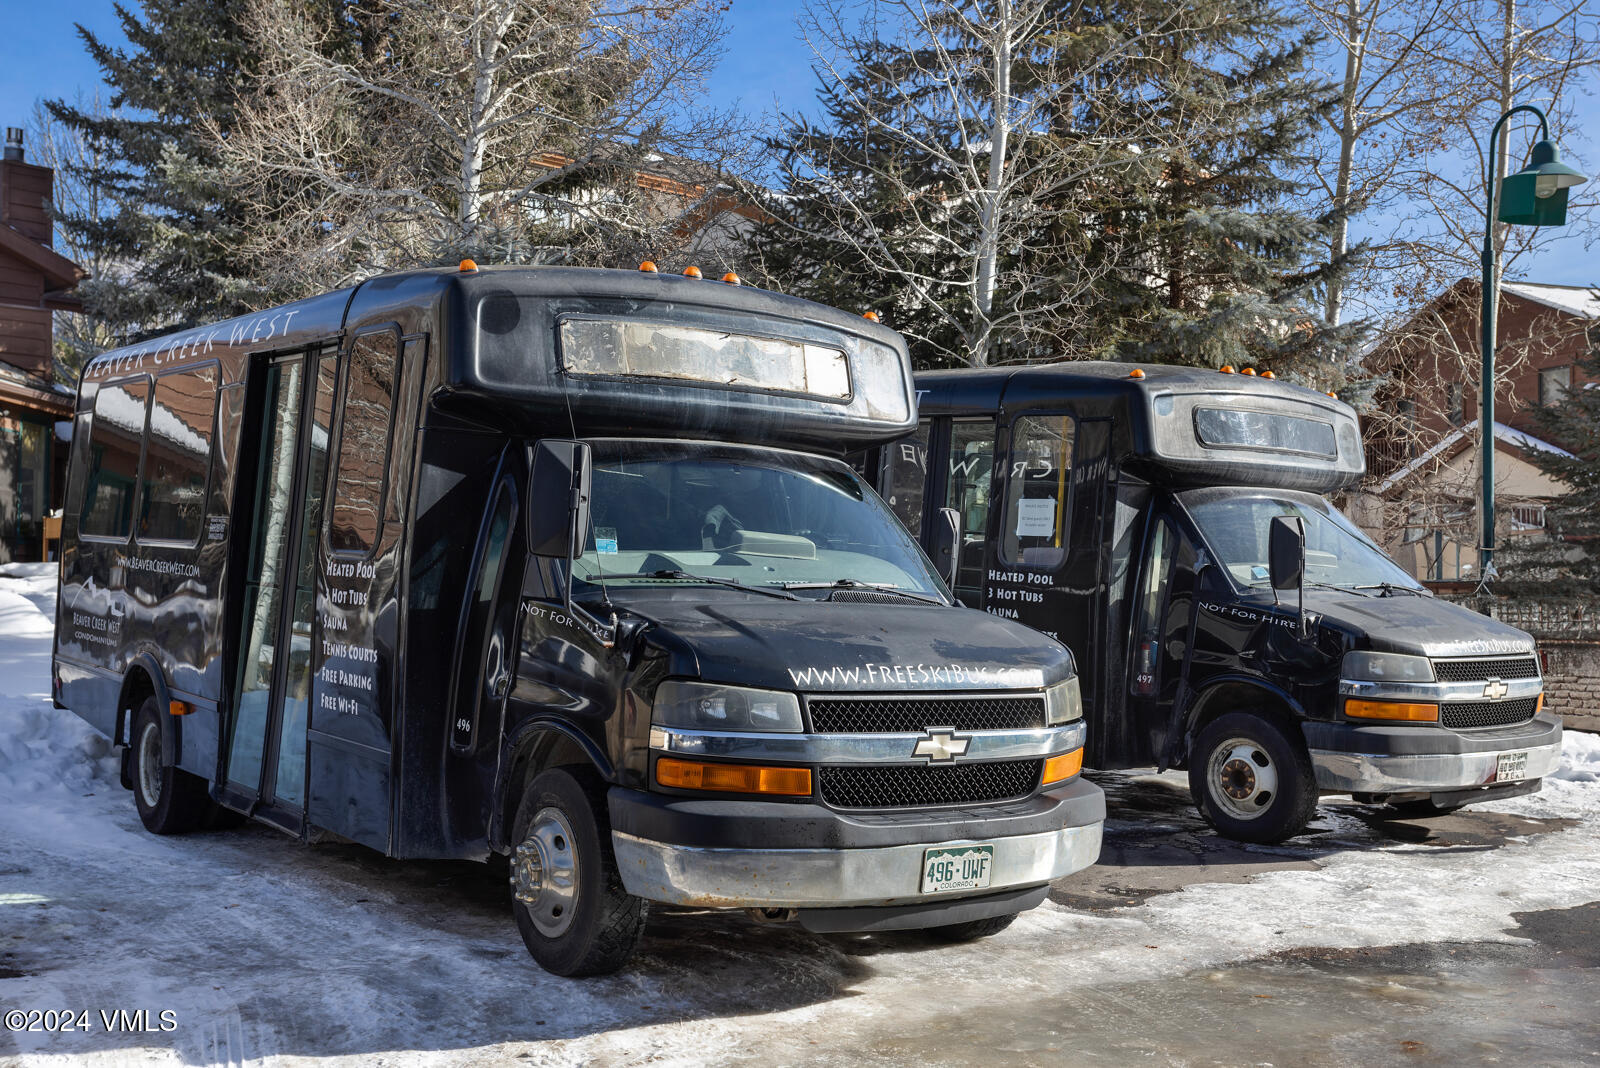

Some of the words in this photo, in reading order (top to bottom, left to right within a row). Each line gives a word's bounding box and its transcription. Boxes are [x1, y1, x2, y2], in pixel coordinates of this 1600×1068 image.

[84, 349, 148, 379] BEAVER
[154, 330, 220, 365] CREEK
[229, 310, 299, 348] WEST
[326, 561, 355, 577] HEATED
[356, 561, 376, 579] POOL
[988, 569, 1025, 583] HEATED
[1027, 572, 1054, 585] POOL
[331, 588, 348, 604] HOT
[348, 589, 367, 606] TUBS
[988, 587, 994, 598] 3
[997, 588, 1018, 601] HOT
[1019, 590, 1043, 602] TUBS
[520, 602, 547, 618] NOT
[549, 611, 574, 628] FOR
[986, 605, 1019, 619] SAUNA
[1199, 601, 1227, 614] NOT
[1231, 608, 1257, 620] FOR
[1262, 615, 1296, 629] HIRE
[73, 611, 91, 628] BEAVER
[92, 616, 107, 631] CREEK
[107, 618, 121, 634] WEST
[323, 613, 348, 631] SAUNA
[74, 631, 117, 647] CONDOMINIUMS
[323, 640, 347, 658] TENNIS
[348, 644, 378, 663] COURTS
[321, 666, 338, 684] FREE
[339, 670, 373, 691] PARKING
[1137, 674, 1153, 685] 497
[320, 693, 337, 711] FREE
[338, 697, 359, 716] WI-FI
[456, 717, 471, 733] 496
[940, 880, 974, 890] COLORADO
